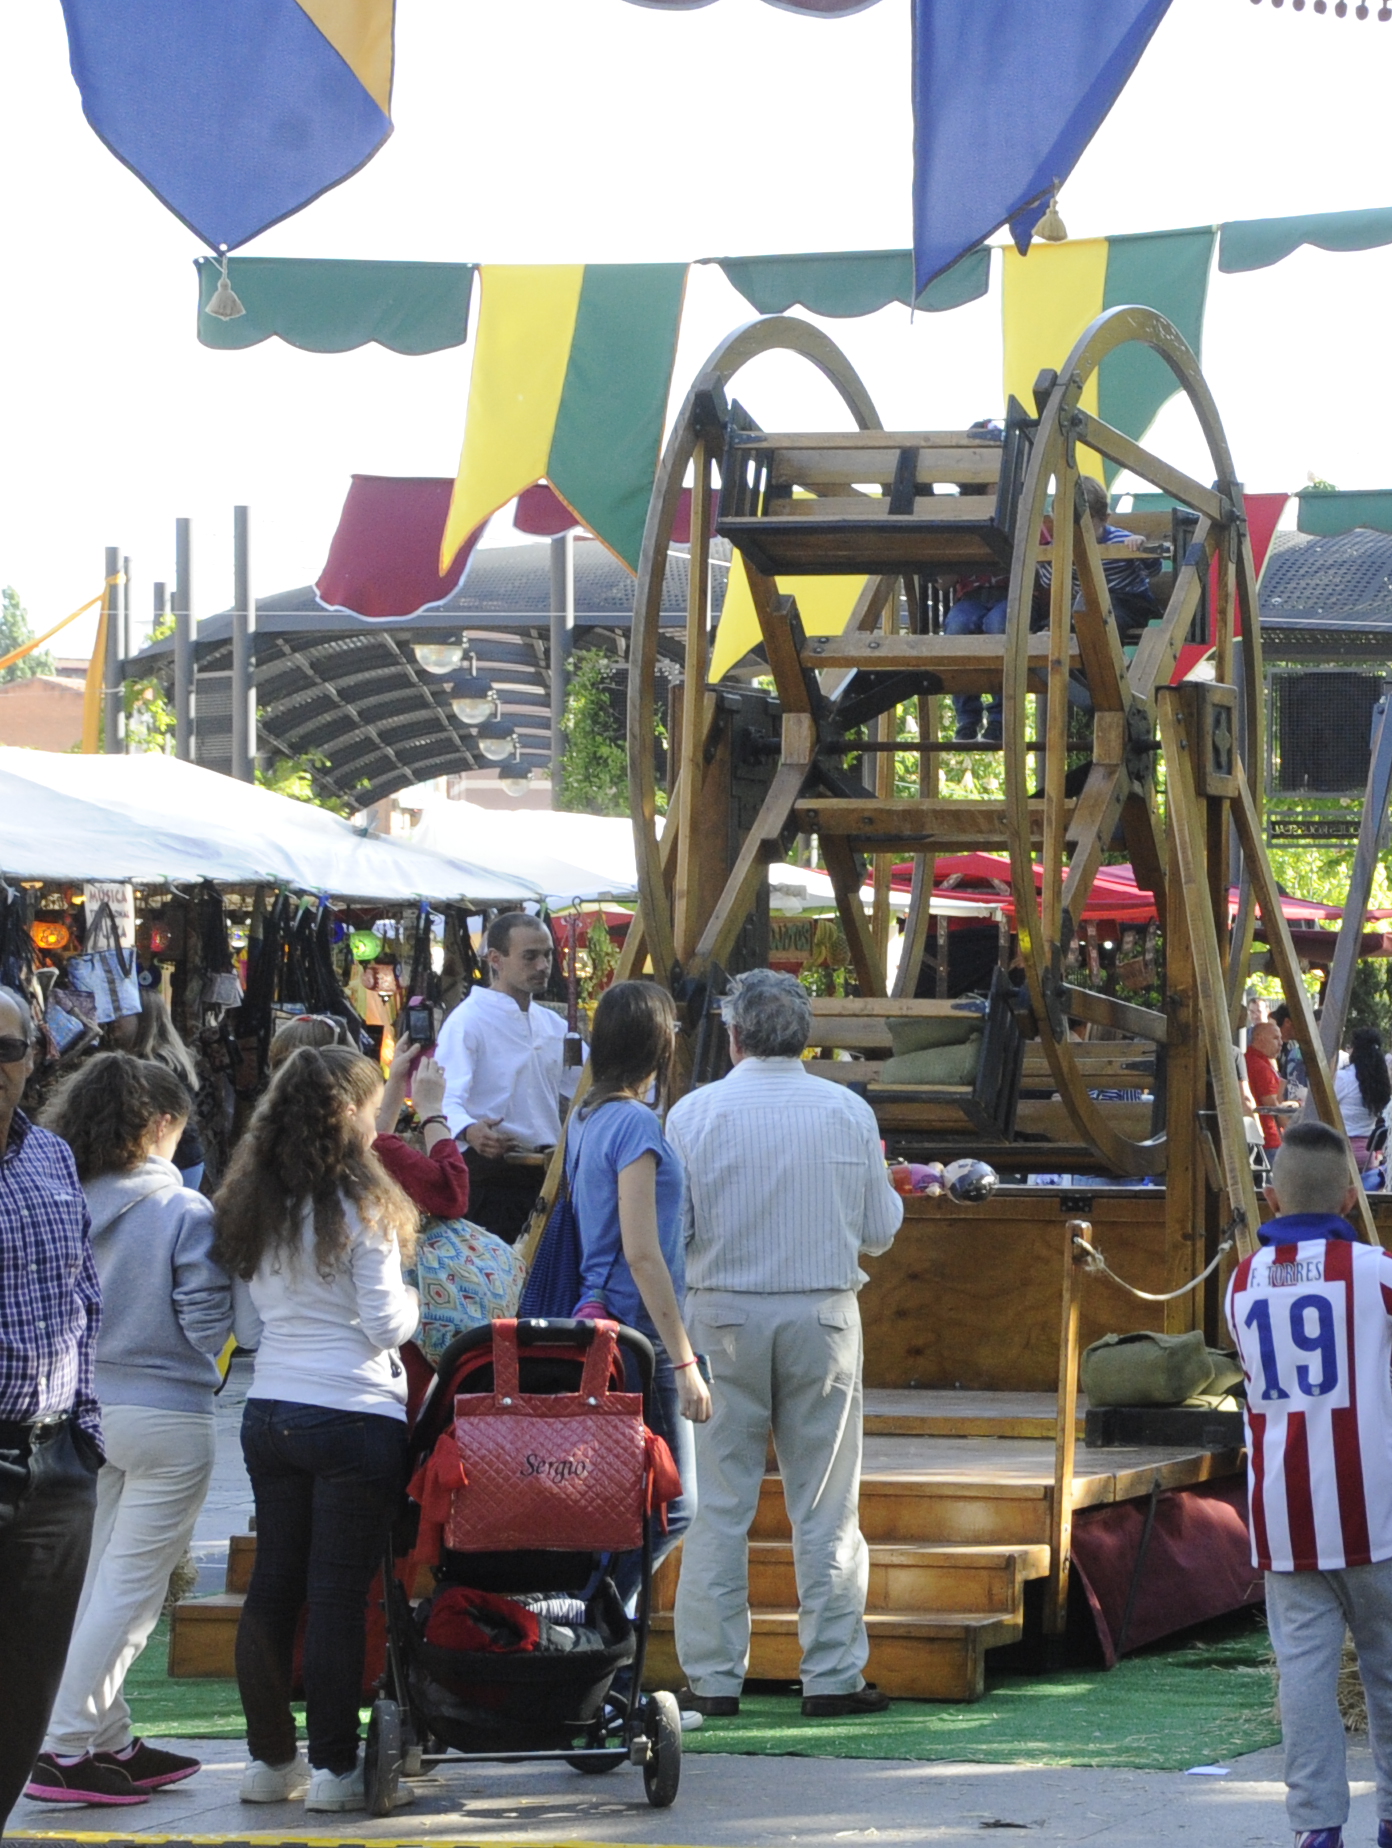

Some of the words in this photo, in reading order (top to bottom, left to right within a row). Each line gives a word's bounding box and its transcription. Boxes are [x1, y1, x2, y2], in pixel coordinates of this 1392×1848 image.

[89, 885, 128, 904] MÚSICA
[1266, 1260, 1323, 1286] TORRES
[1244, 1293, 1339, 1401] 19
[520, 1453, 587, 1484] Sergio
